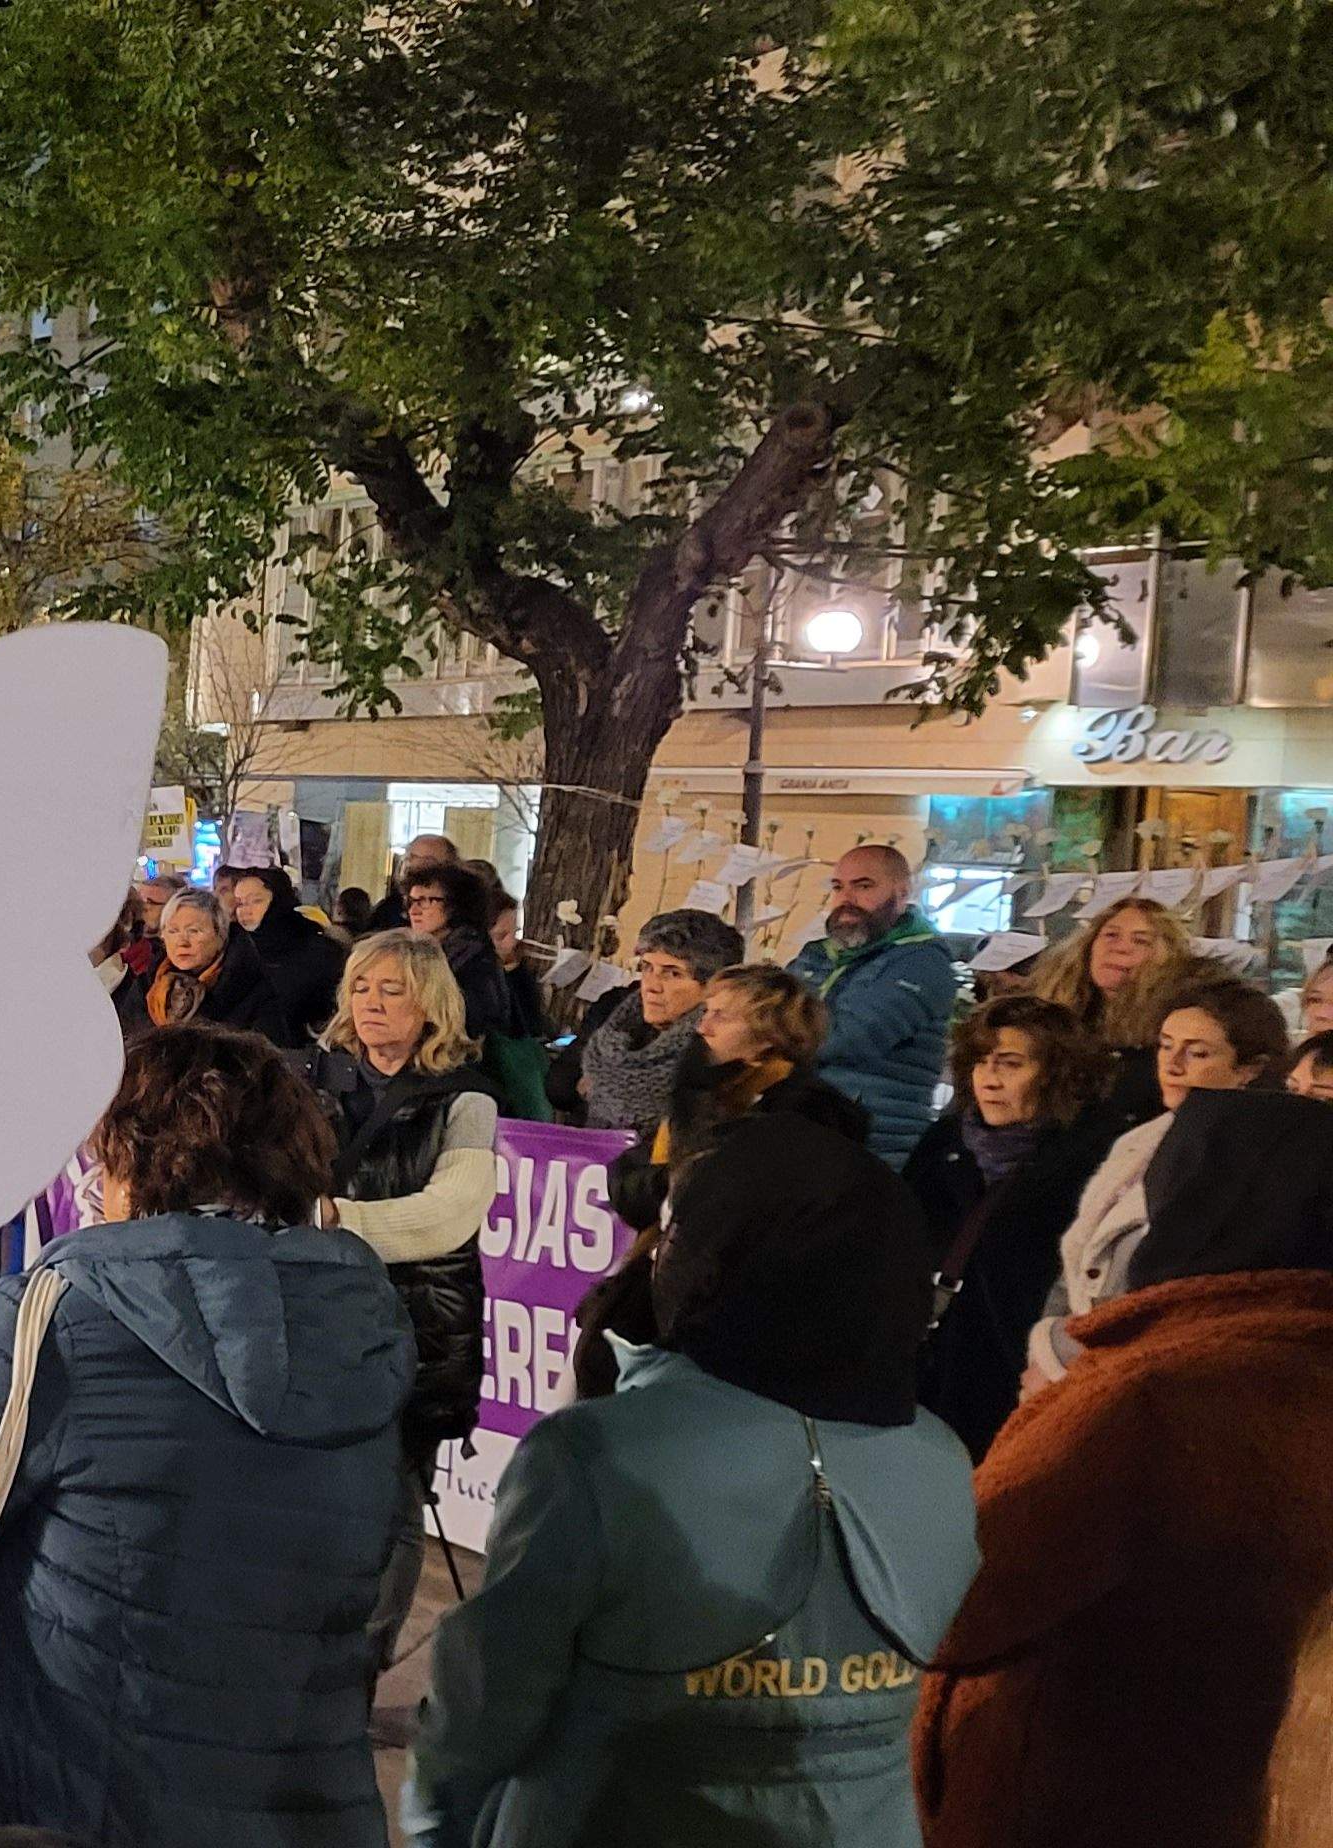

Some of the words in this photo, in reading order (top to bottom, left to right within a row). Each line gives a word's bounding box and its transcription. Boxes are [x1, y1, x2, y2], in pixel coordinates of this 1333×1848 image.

[1071, 705, 1233, 765] Bar
[479, 1155, 614, 1274] CIAS
[684, 1657, 828, 1698] WORLD
